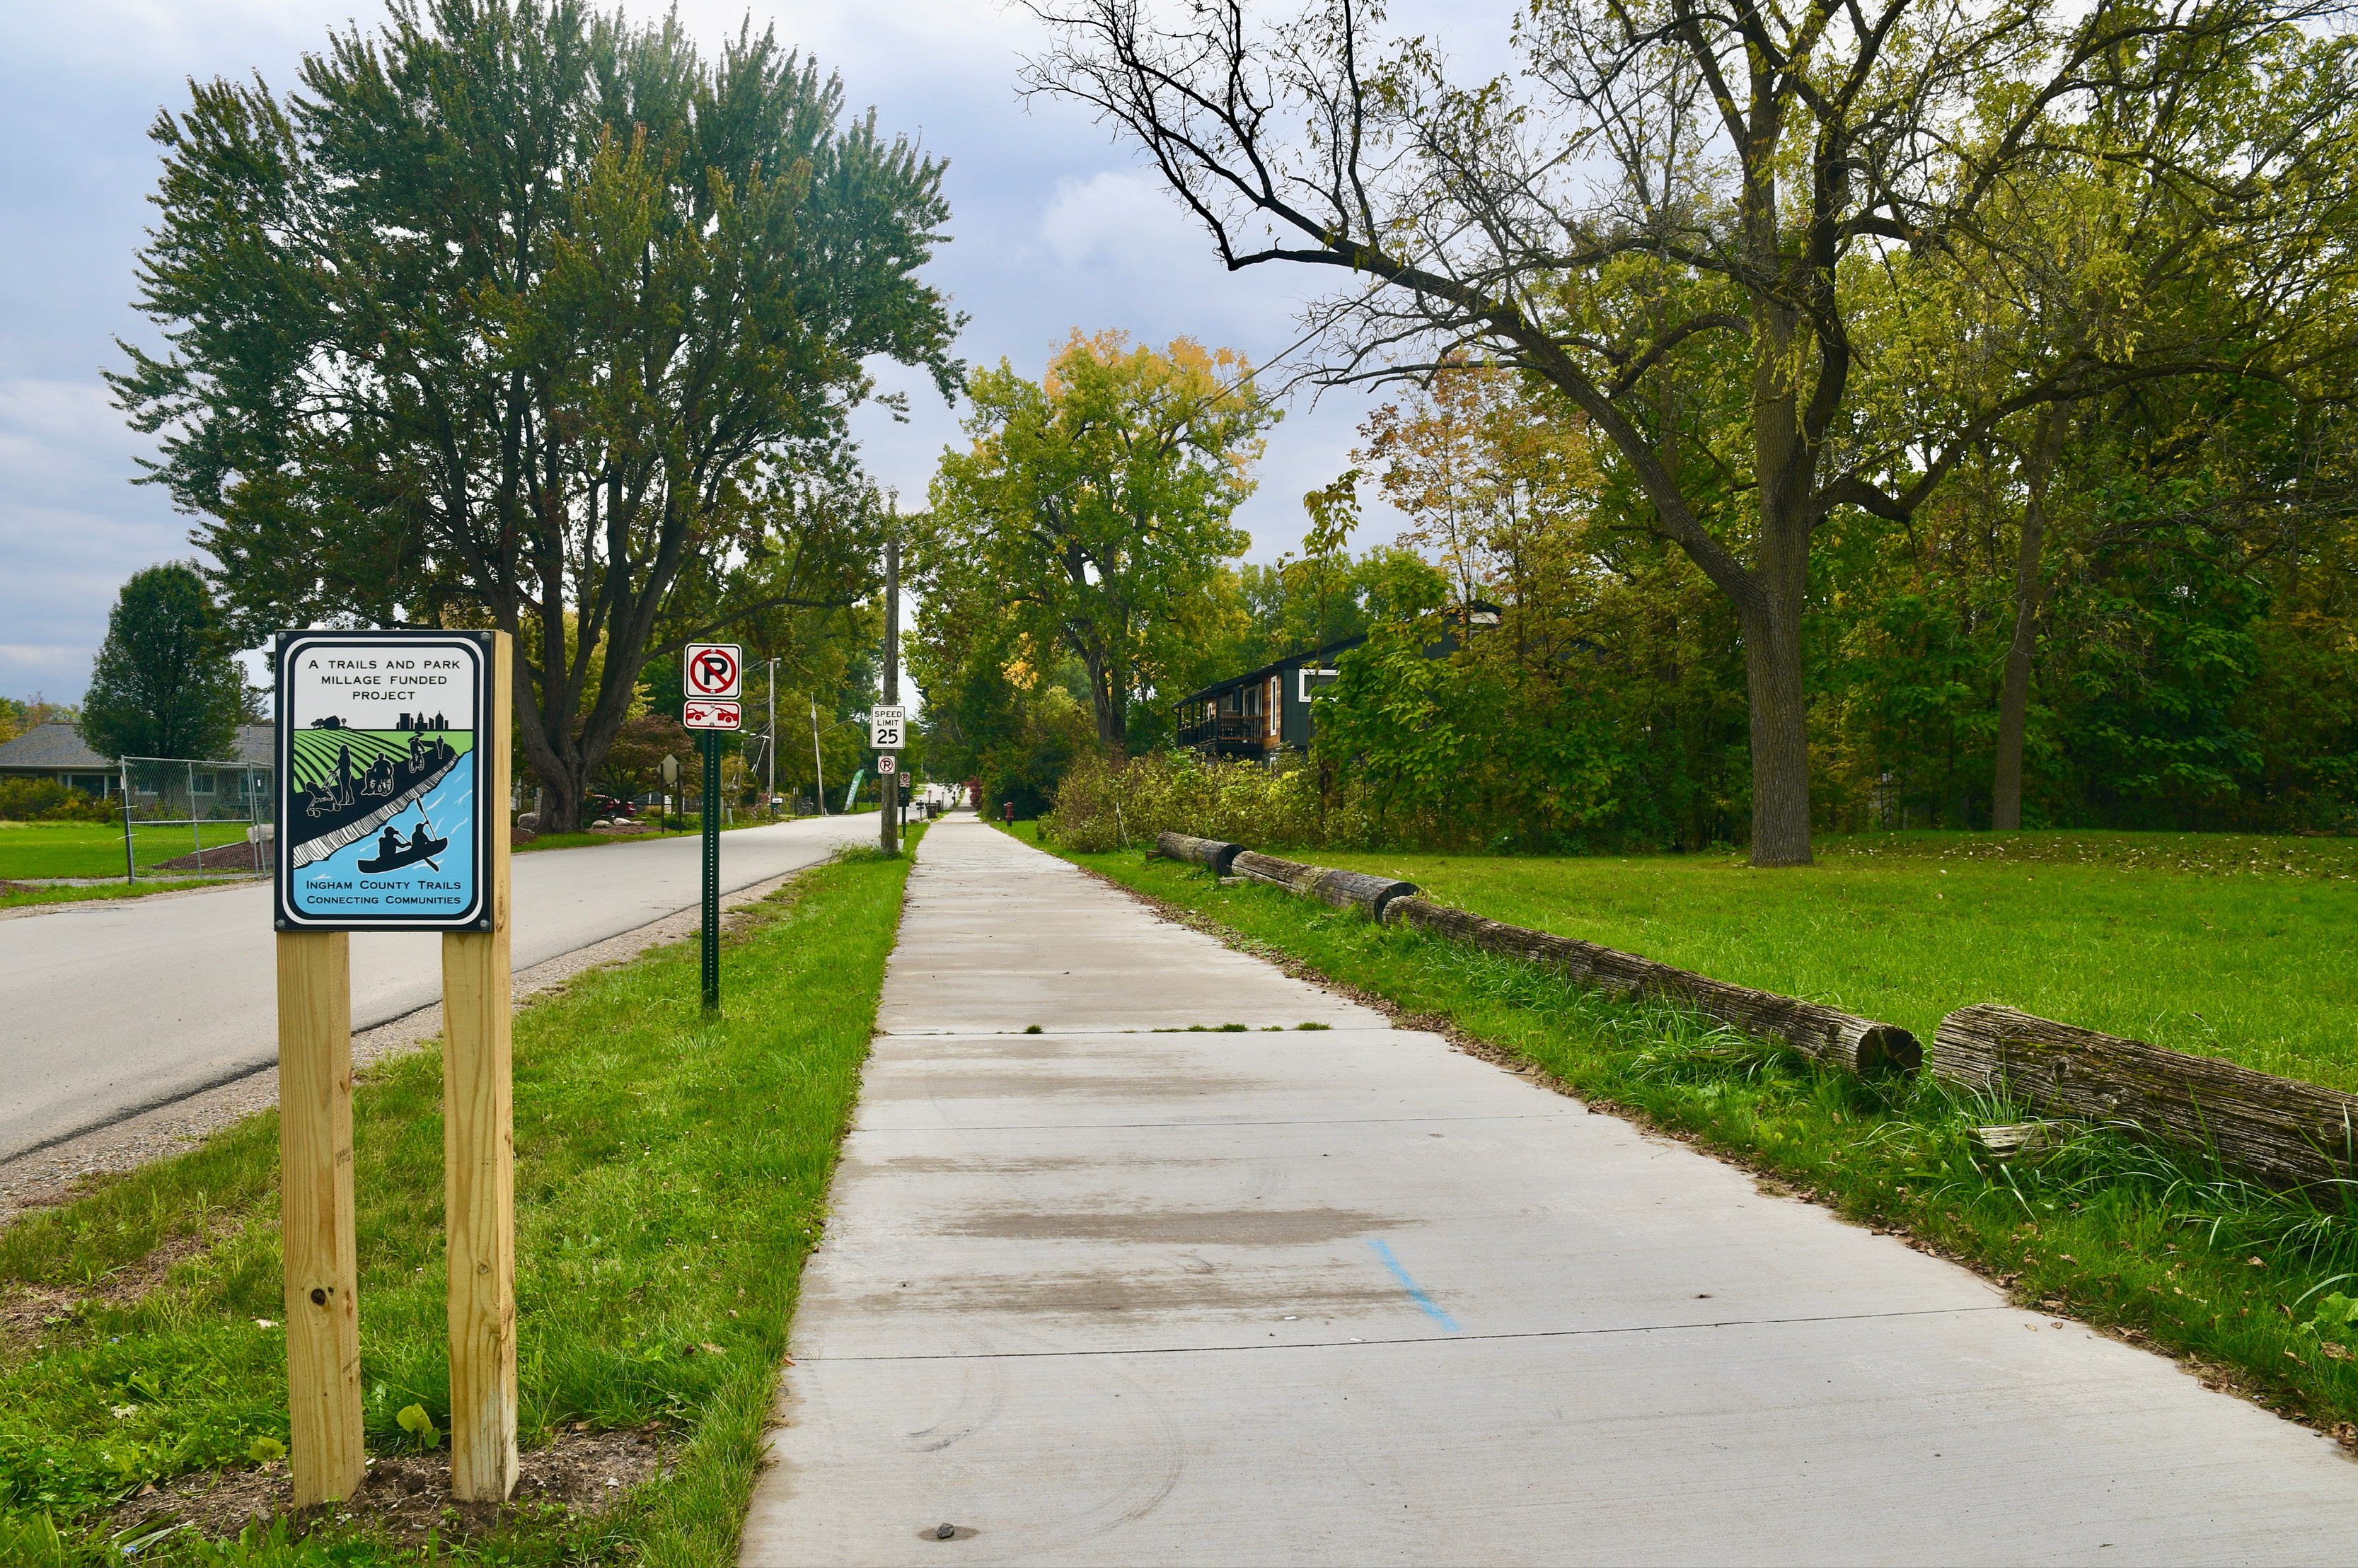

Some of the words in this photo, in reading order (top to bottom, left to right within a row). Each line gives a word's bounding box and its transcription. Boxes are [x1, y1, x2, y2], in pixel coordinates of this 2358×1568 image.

[308, 659, 319, 669] A
[328, 660, 377, 669] TRAILS
[386, 661, 415, 669] AND
[424, 661, 461, 669] PARK
[704, 657, 728, 685] P
[321, 675, 381, 685] MILLAGE
[390, 676, 447, 685] FUNDED
[352, 691, 416, 700] PROJECT
[877, 728, 898, 744] 25
